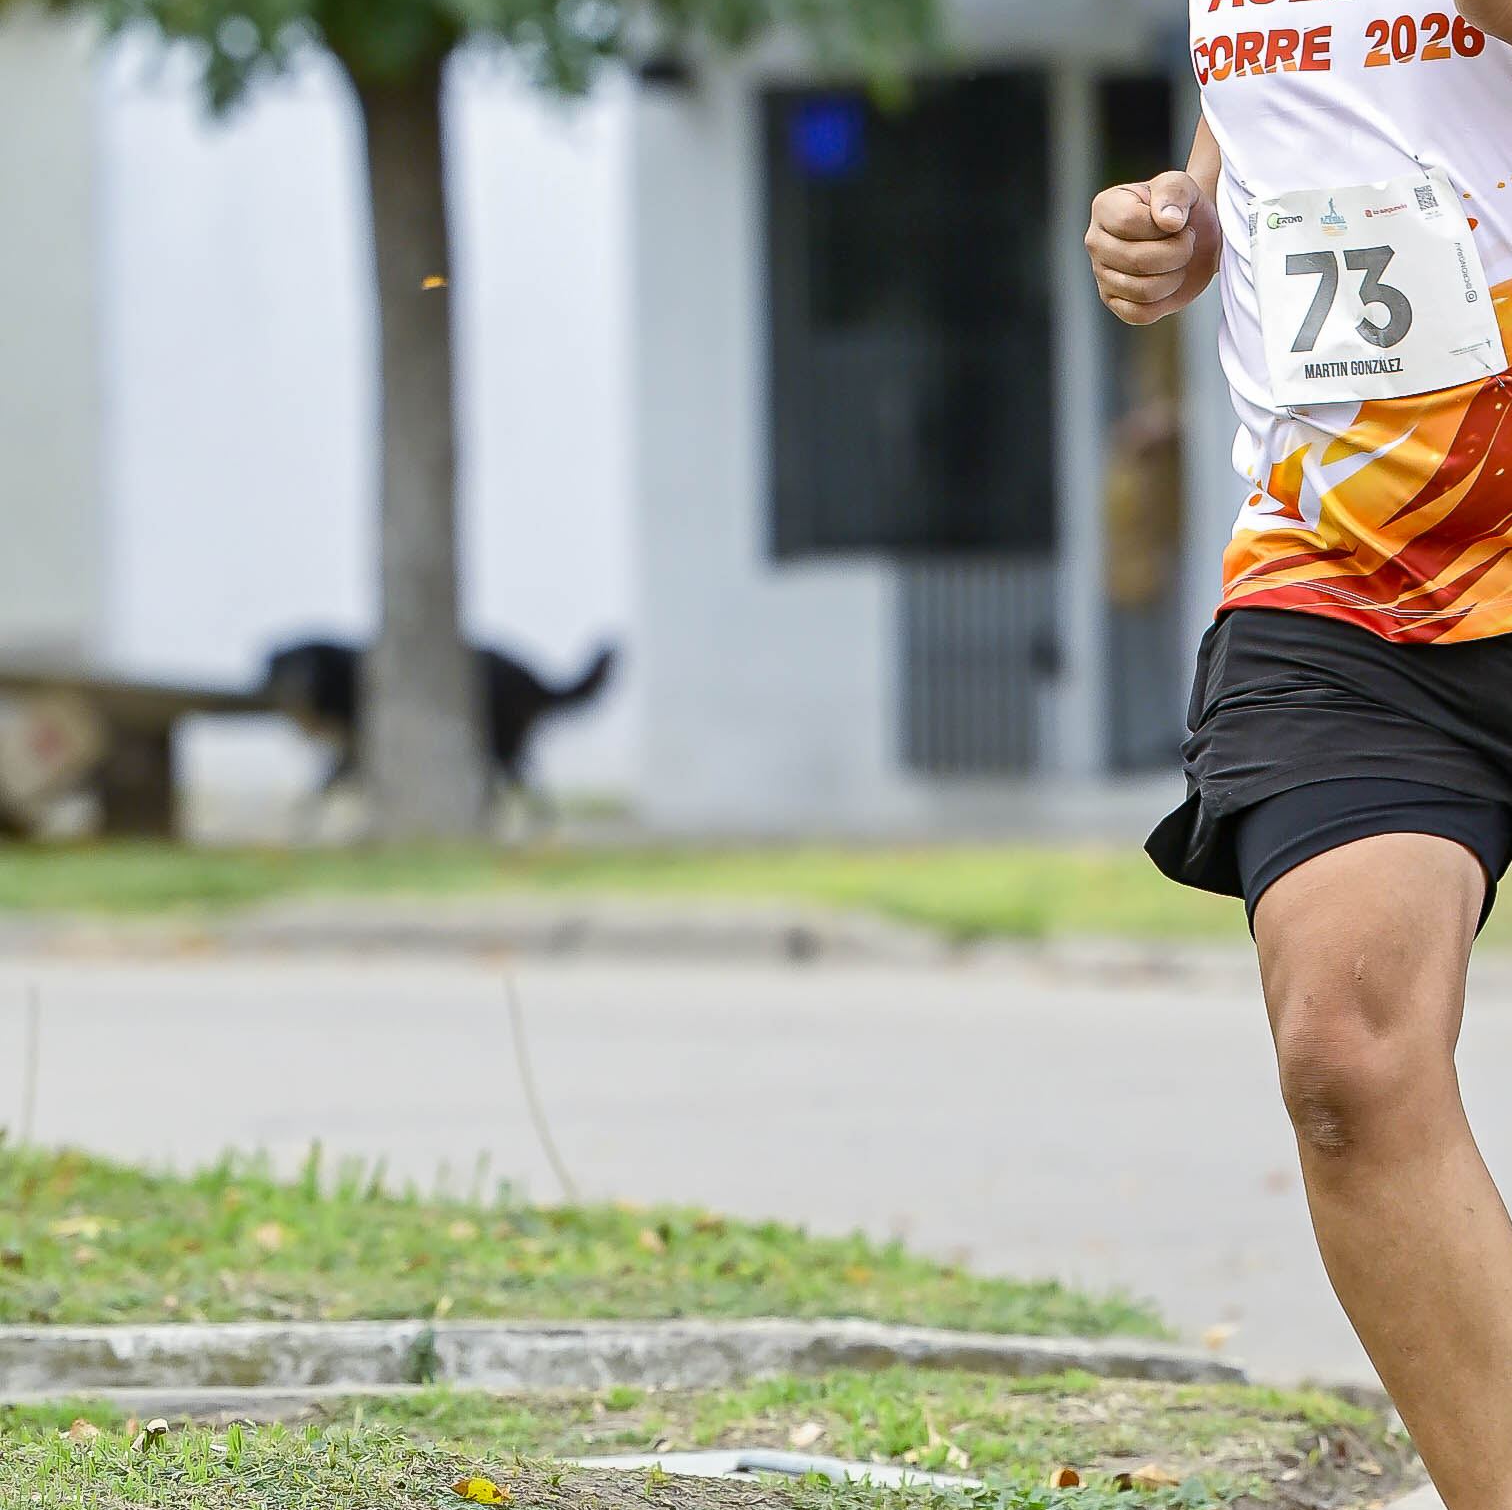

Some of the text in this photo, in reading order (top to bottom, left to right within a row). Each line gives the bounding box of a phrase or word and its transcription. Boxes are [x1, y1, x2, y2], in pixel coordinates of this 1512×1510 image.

[1194, 12, 1486, 85] CORRE 2026
[1286, 244, 1413, 352] 73
[1305, 362, 1348, 379] MARTIN
